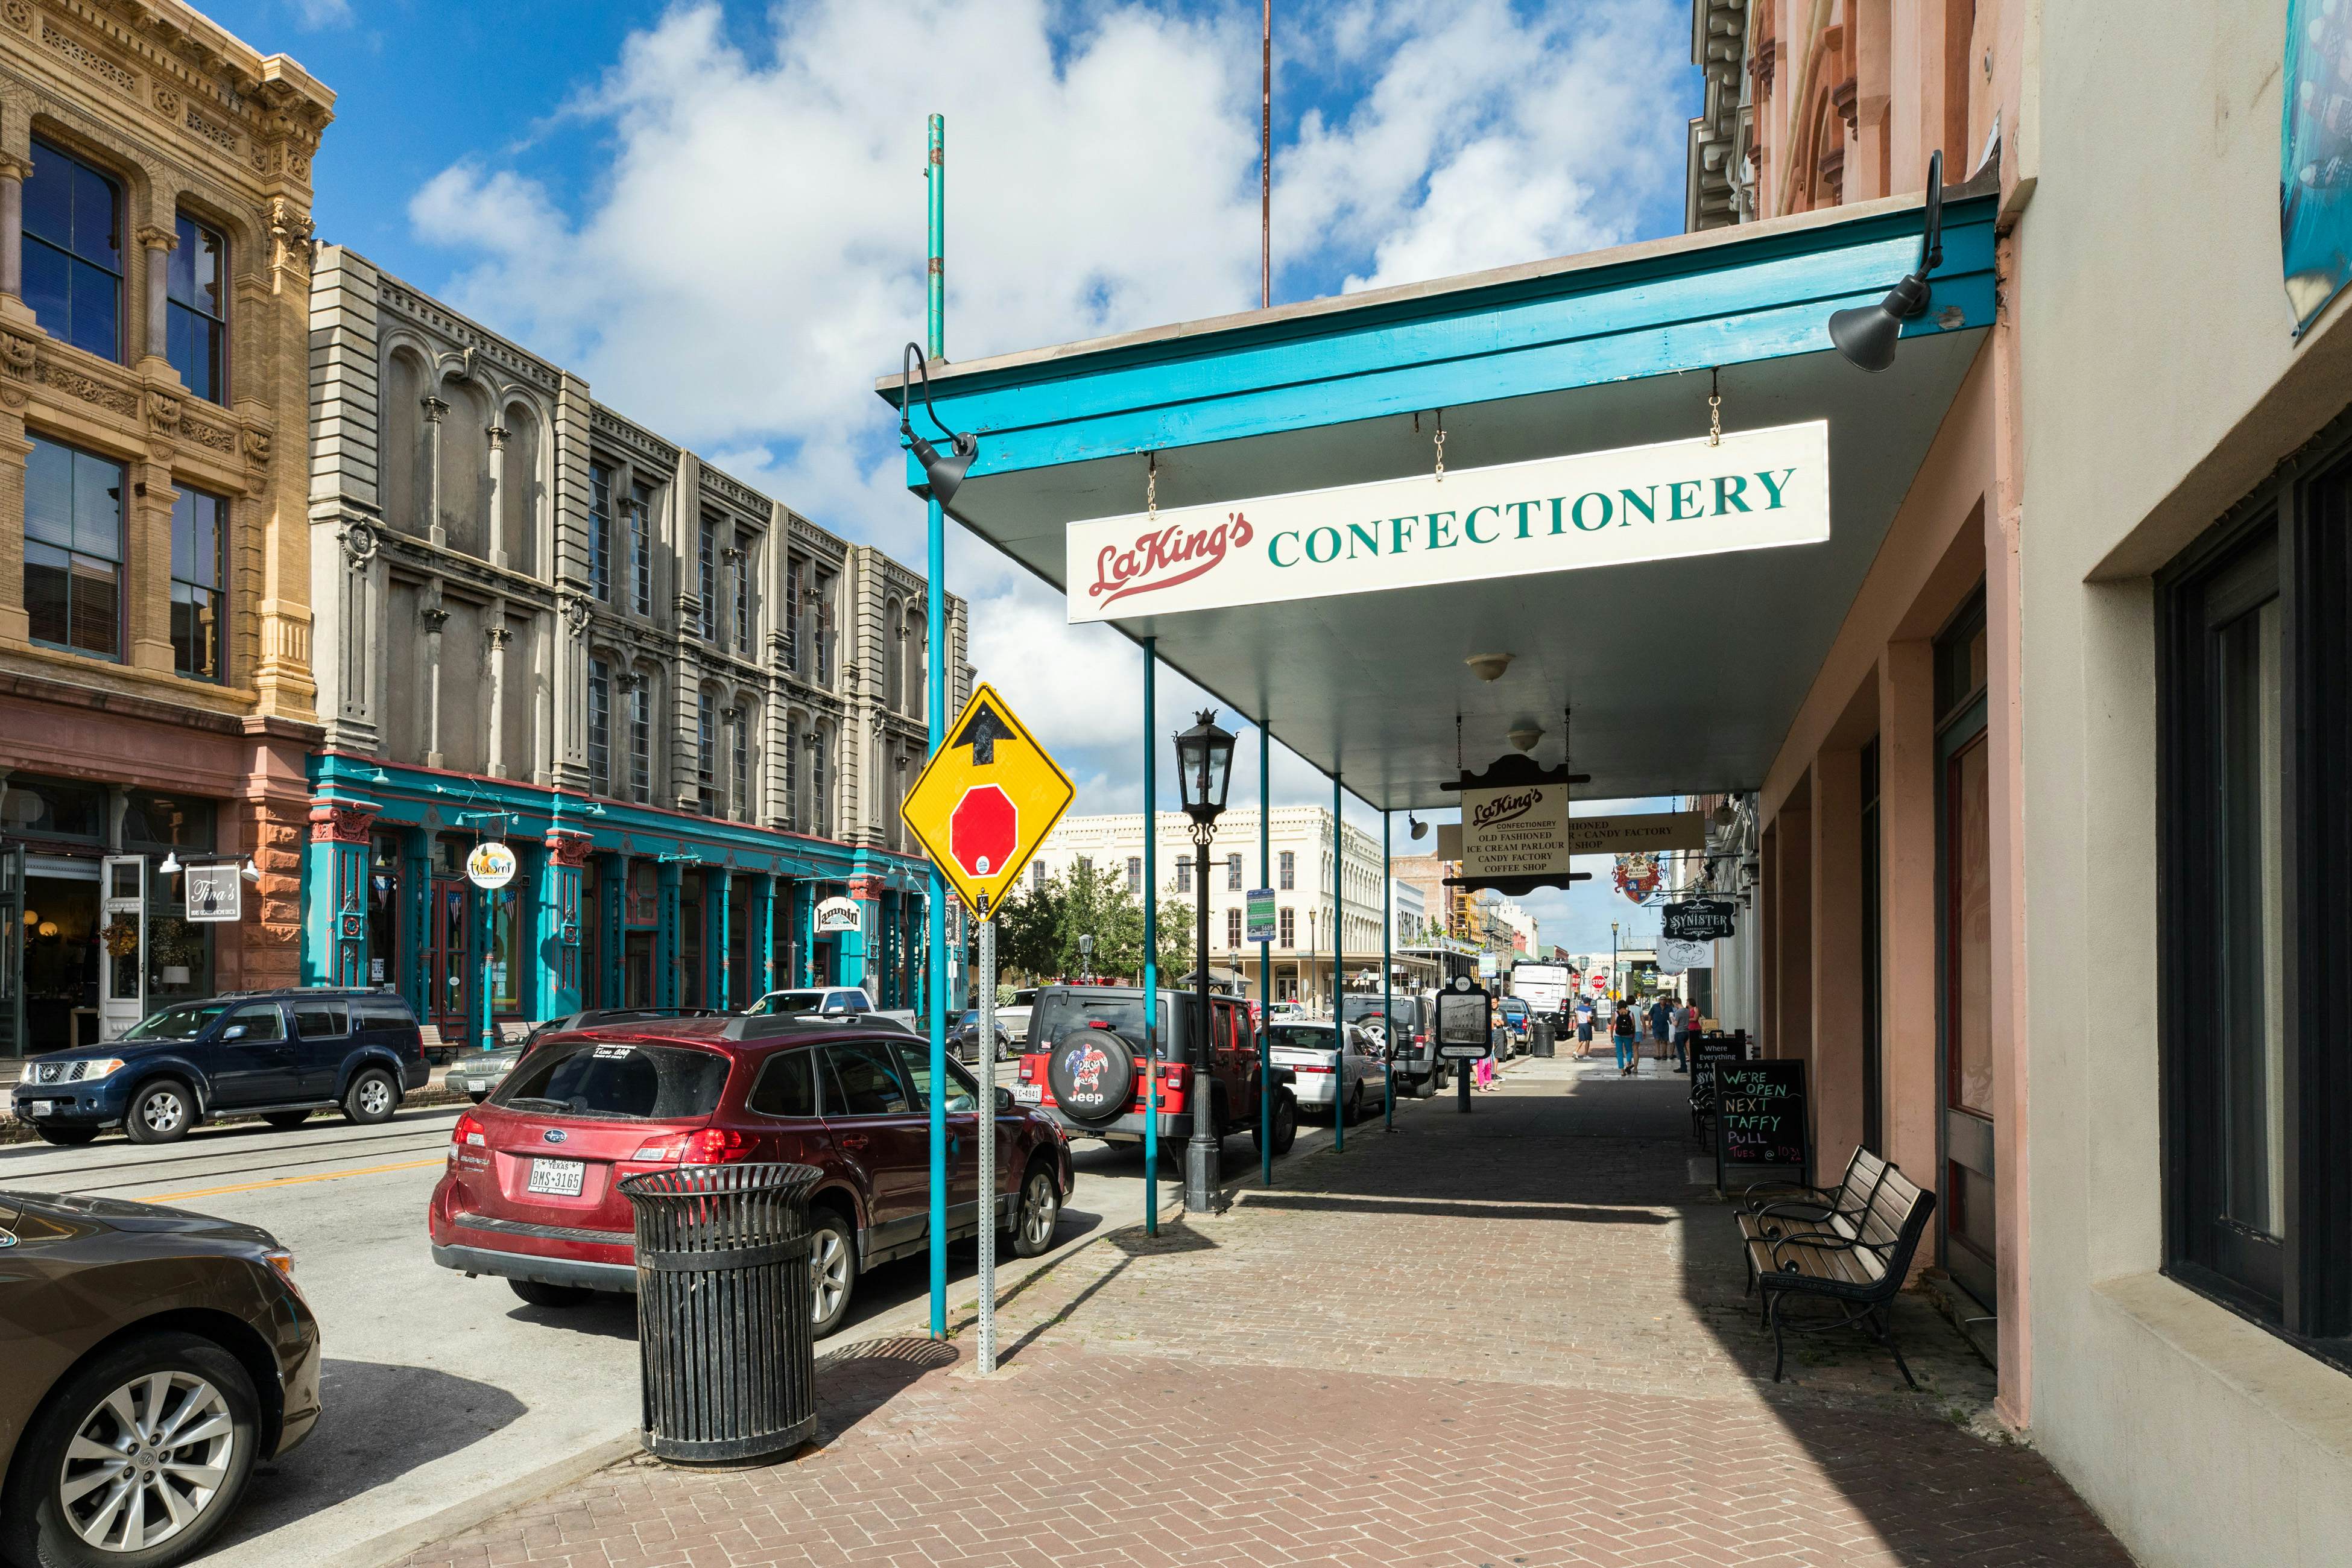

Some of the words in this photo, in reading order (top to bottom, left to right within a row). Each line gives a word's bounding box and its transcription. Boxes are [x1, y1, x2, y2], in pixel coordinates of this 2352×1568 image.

[1087, 511, 1254, 610] LaKing's
[1266, 467, 1798, 568] CONFECTIONERY
[1472, 788, 1543, 830] LaKing's
[1496, 820, 1557, 829] CONFECTIONERY
[1569, 821, 1609, 830] HIONED
[1500, 832, 1552, 841] FASHIONED
[1584, 829, 1620, 839] CANDY
[1625, 826, 1672, 836] FACTORY
[1485, 844, 1517, 852] CREAM
[1521, 841, 1565, 850] PARLOUR
[1575, 841, 1602, 849] SHOP
[1512, 852, 1553, 861] FACTORY
[470, 861, 511, 876] tsunami
[1484, 864, 1520, 873] COFFEE
[1523, 863, 1547, 871] SHOP
[191, 879, 235, 902] Tina's
[817, 908, 860, 931] Jammin'
[1723, 1070, 1766, 1084] WE'RE
[1746, 1084, 1786, 1096] OPEN
[1068, 1090, 1104, 1105] Jeep
[1725, 1098, 1771, 1112] NEXT
[1724, 1115, 1781, 1131] TAFFY
[1728, 1131, 1768, 1144] PULL
[1765, 1150, 1775, 1161] @
